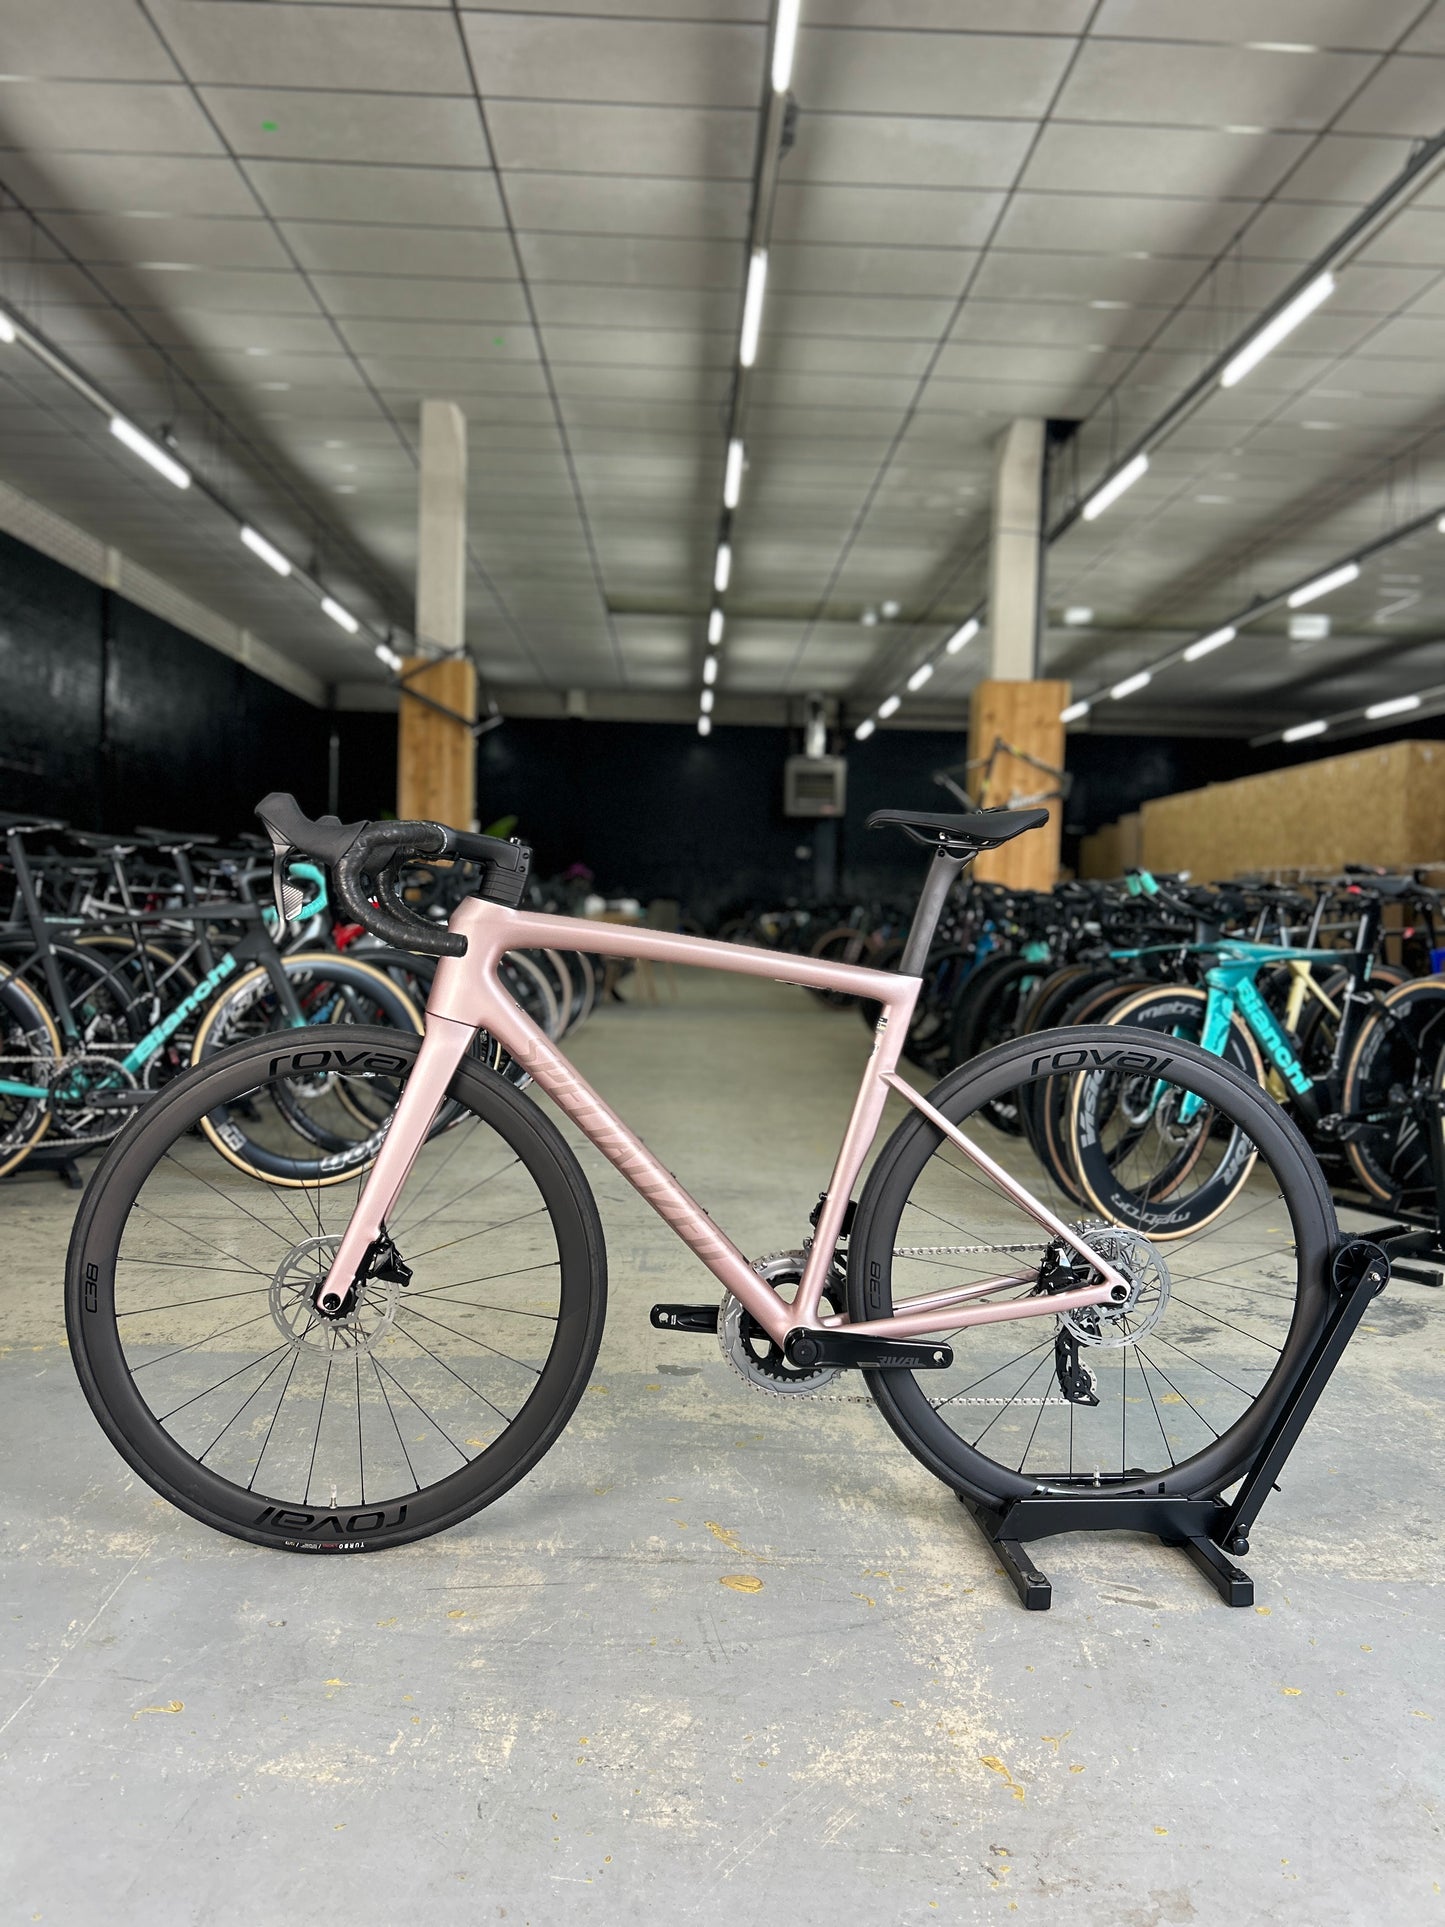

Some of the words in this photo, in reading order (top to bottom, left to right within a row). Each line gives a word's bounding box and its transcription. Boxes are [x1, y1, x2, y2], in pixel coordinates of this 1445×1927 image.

[131, 952, 237, 1065] Bianchi
[1236, 976, 1315, 1095] Bianchi
[269, 1050, 413, 1077] rova
[1030, 1049, 1174, 1076] roval
[85, 1262, 98, 1313] C38
[870, 1261, 880, 1310] C38
[253, 1504, 408, 1534] roval
